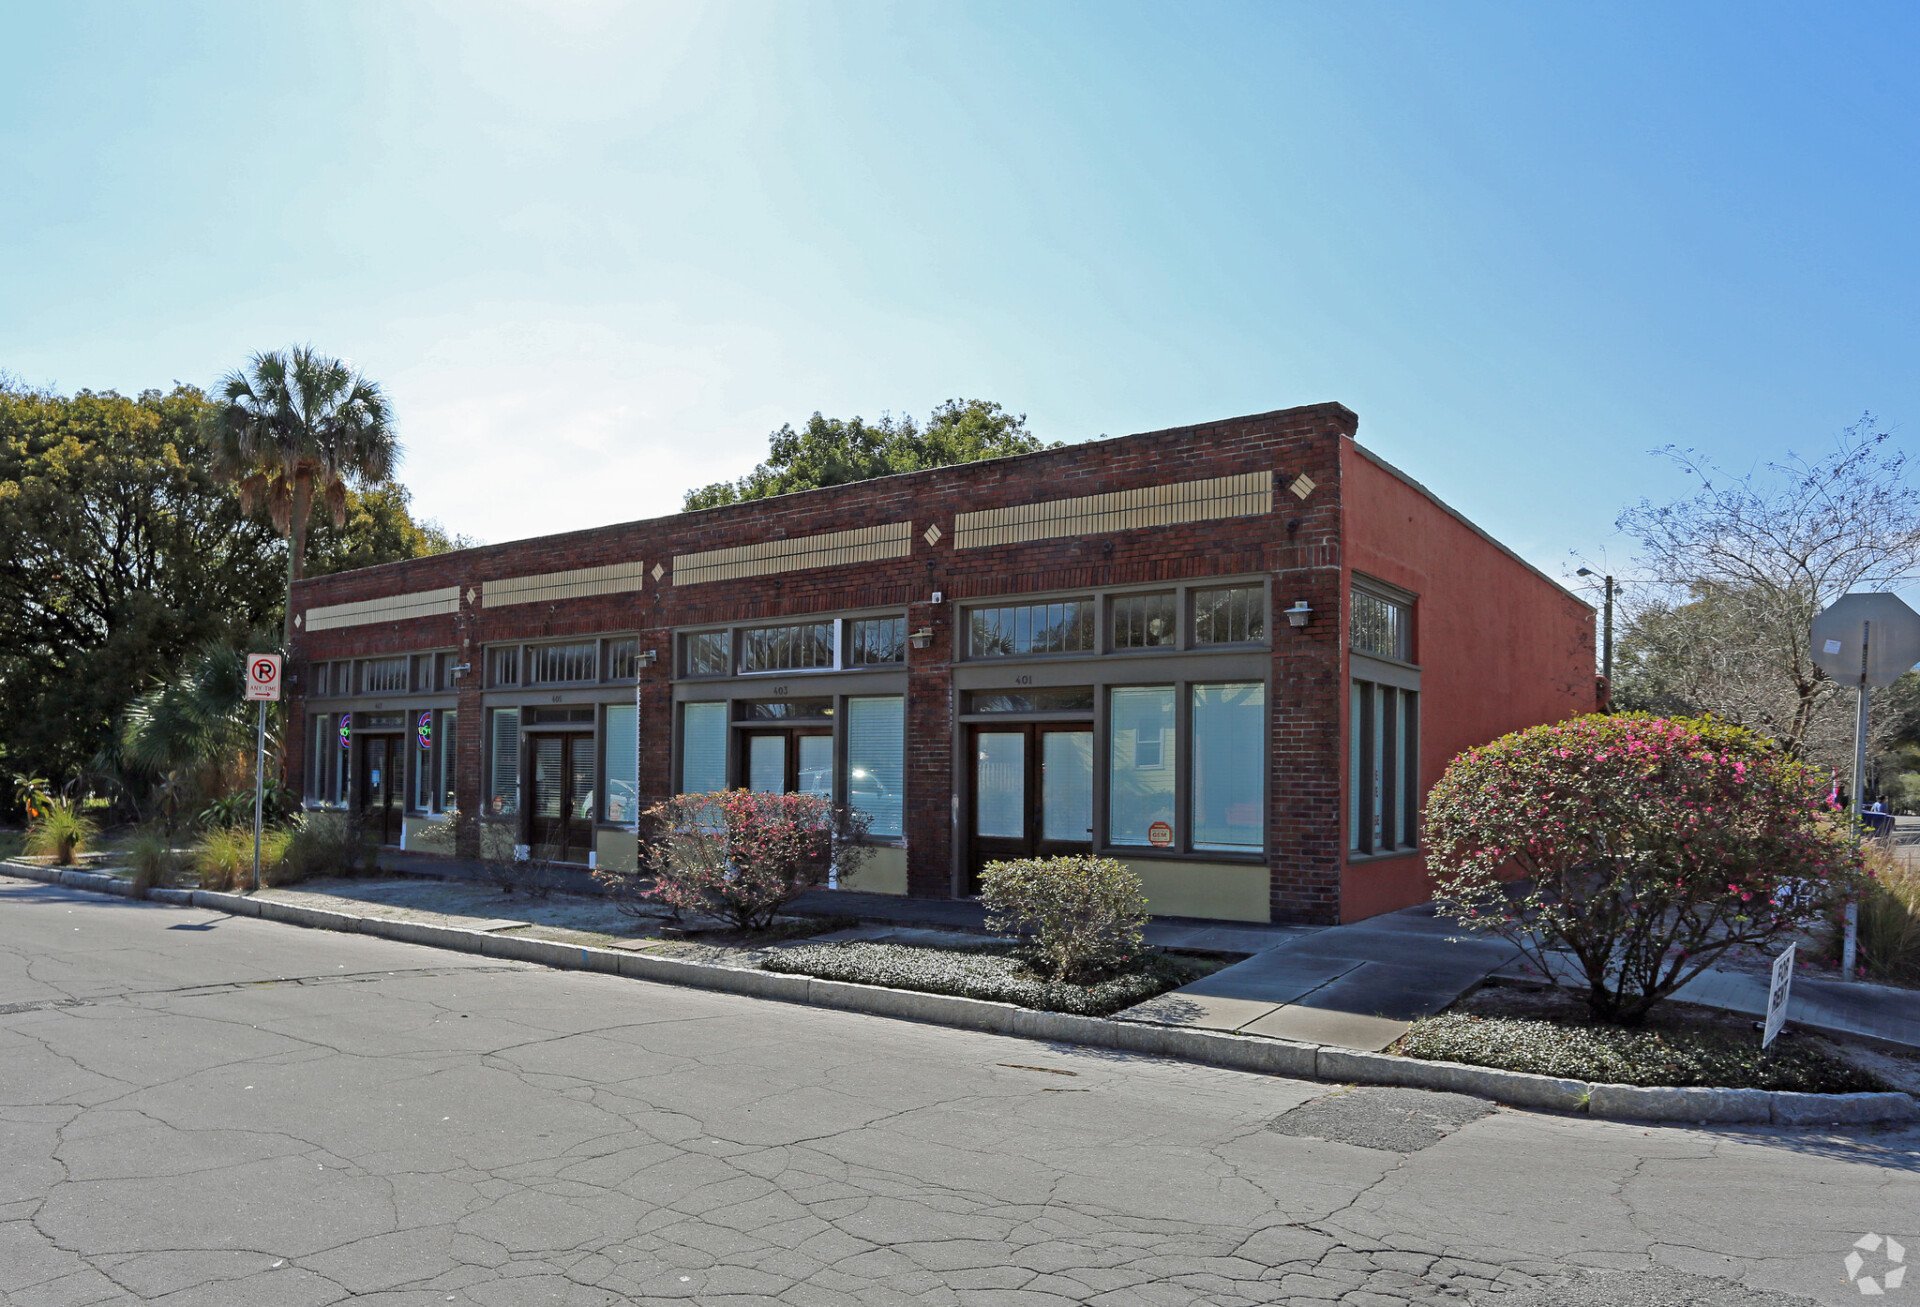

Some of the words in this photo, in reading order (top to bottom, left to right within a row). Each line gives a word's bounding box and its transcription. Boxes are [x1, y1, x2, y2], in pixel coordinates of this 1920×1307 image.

[259, 663, 272, 679] P
[1015, 674, 1032, 685] 401
[773, 685, 788, 696] 403
